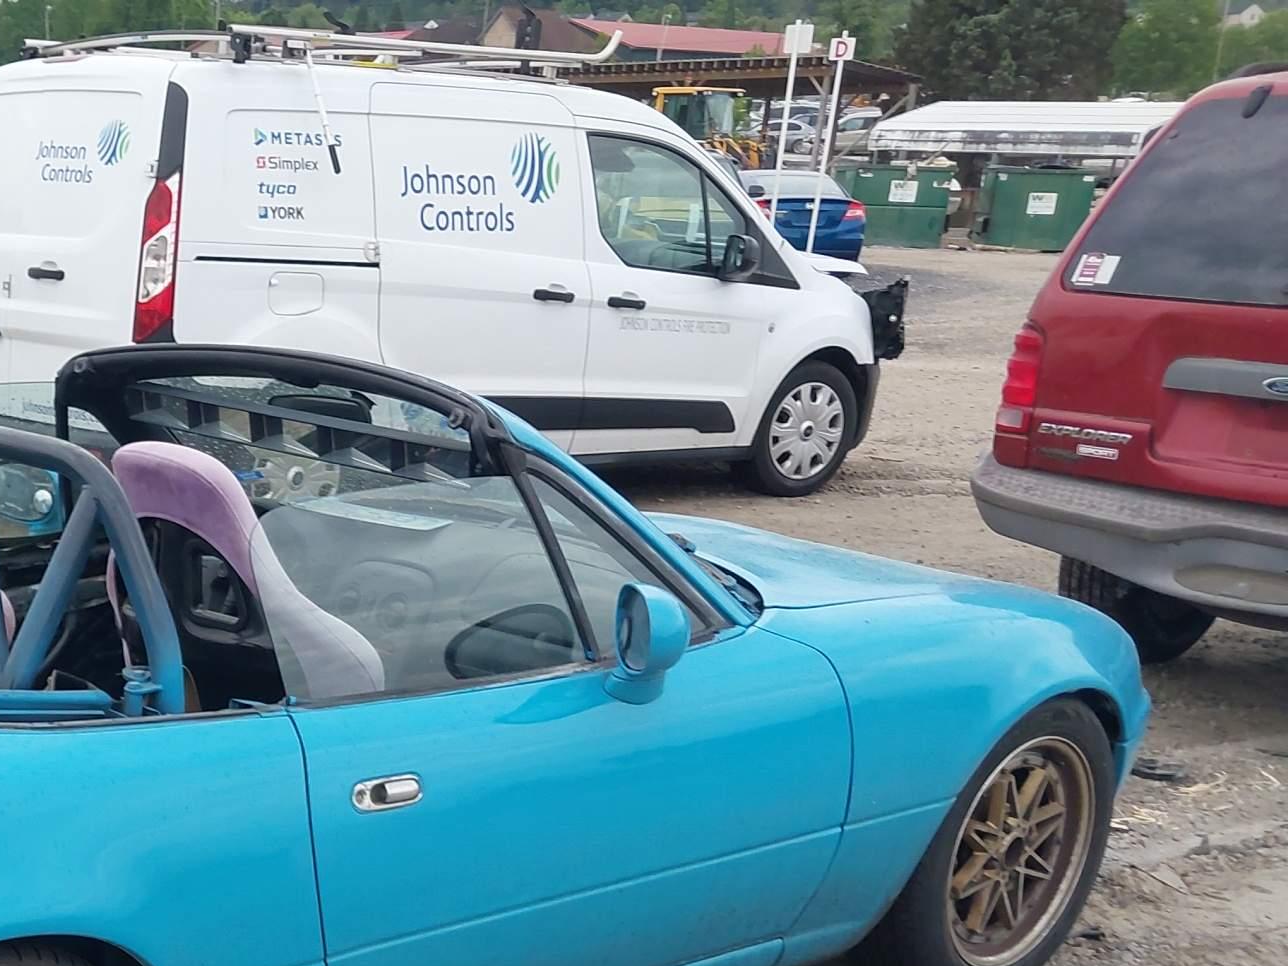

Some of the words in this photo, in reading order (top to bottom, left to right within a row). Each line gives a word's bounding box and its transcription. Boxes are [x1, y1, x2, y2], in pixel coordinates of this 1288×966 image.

[835, 40, 849, 59] D
[270, 131, 343, 148] METASS
[35, 140, 87, 161] Johnson
[41, 163, 94, 184] Controls
[268, 156, 319, 173] Simplex
[257, 182, 297, 198] tyco
[401, 163, 496, 197] Johnson
[270, 206, 305, 220] YORK
[420, 202, 515, 232] Controls
[1038, 422, 1132, 444] EXPLORER
